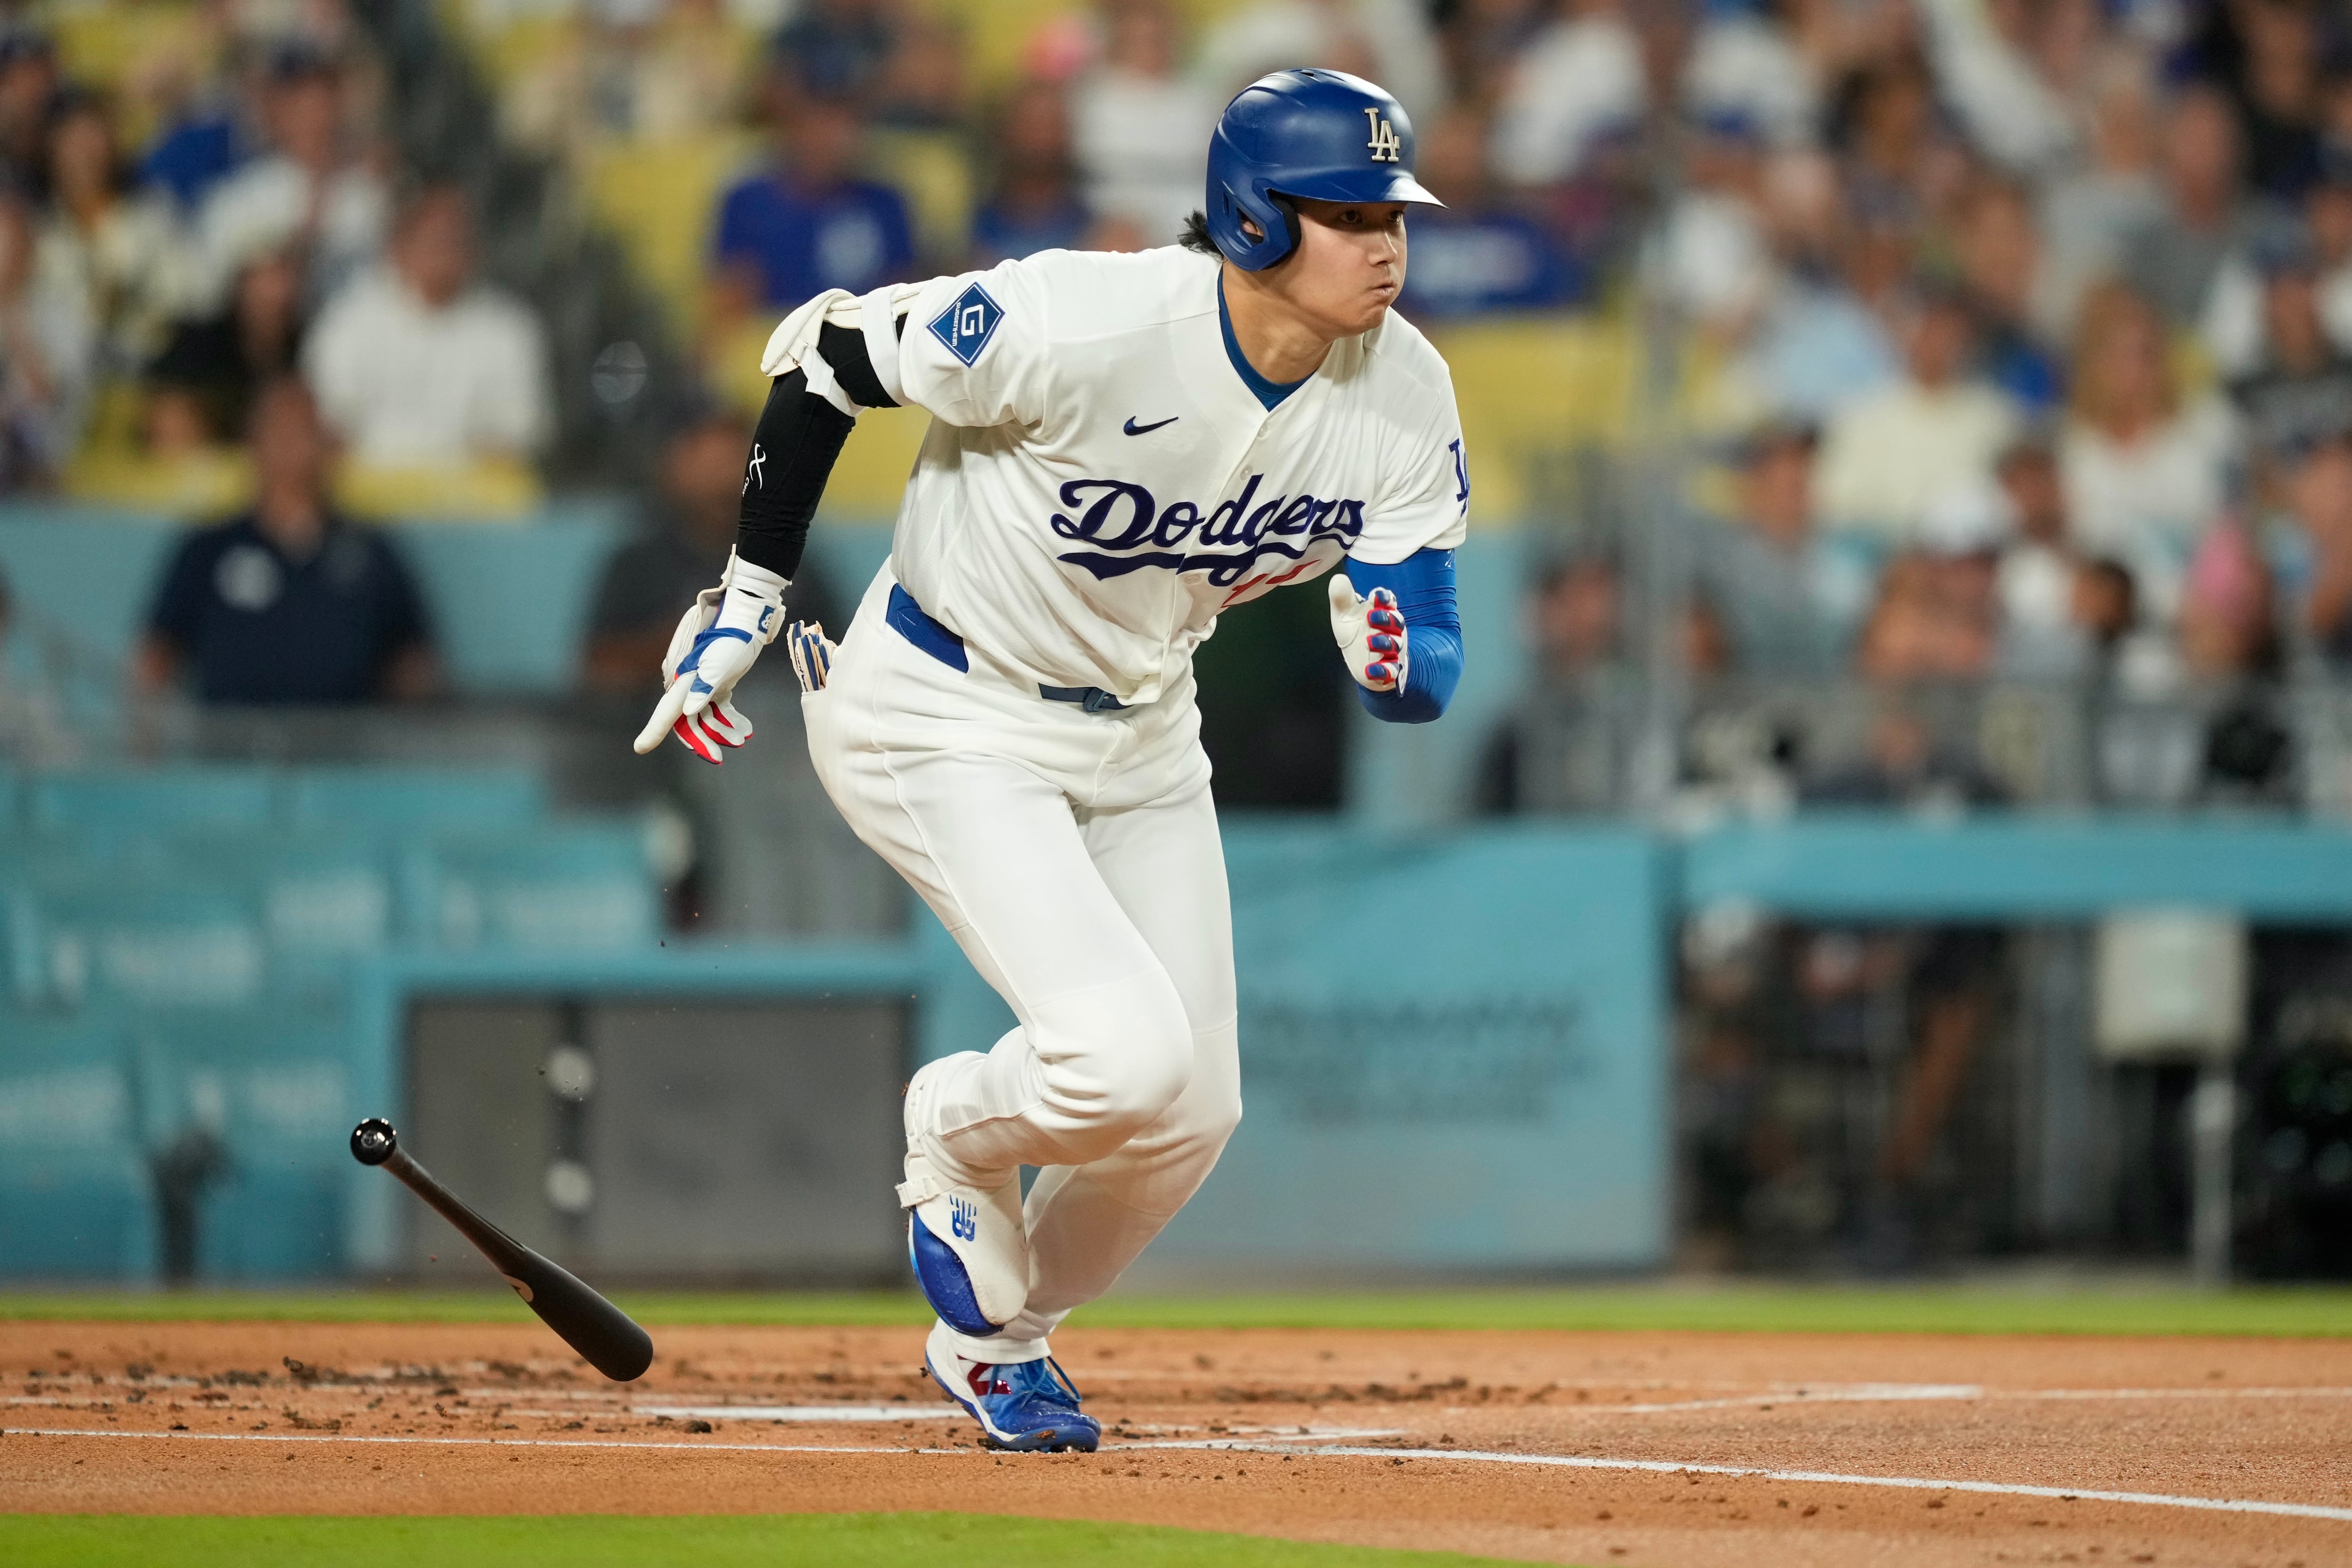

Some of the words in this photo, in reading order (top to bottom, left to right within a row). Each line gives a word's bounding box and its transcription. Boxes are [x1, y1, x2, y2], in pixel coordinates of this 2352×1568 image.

[1364, 108, 1400, 162] LA
[952, 302, 961, 347] GUGGENHEIM
[1050, 473, 1366, 587] Dodgers
